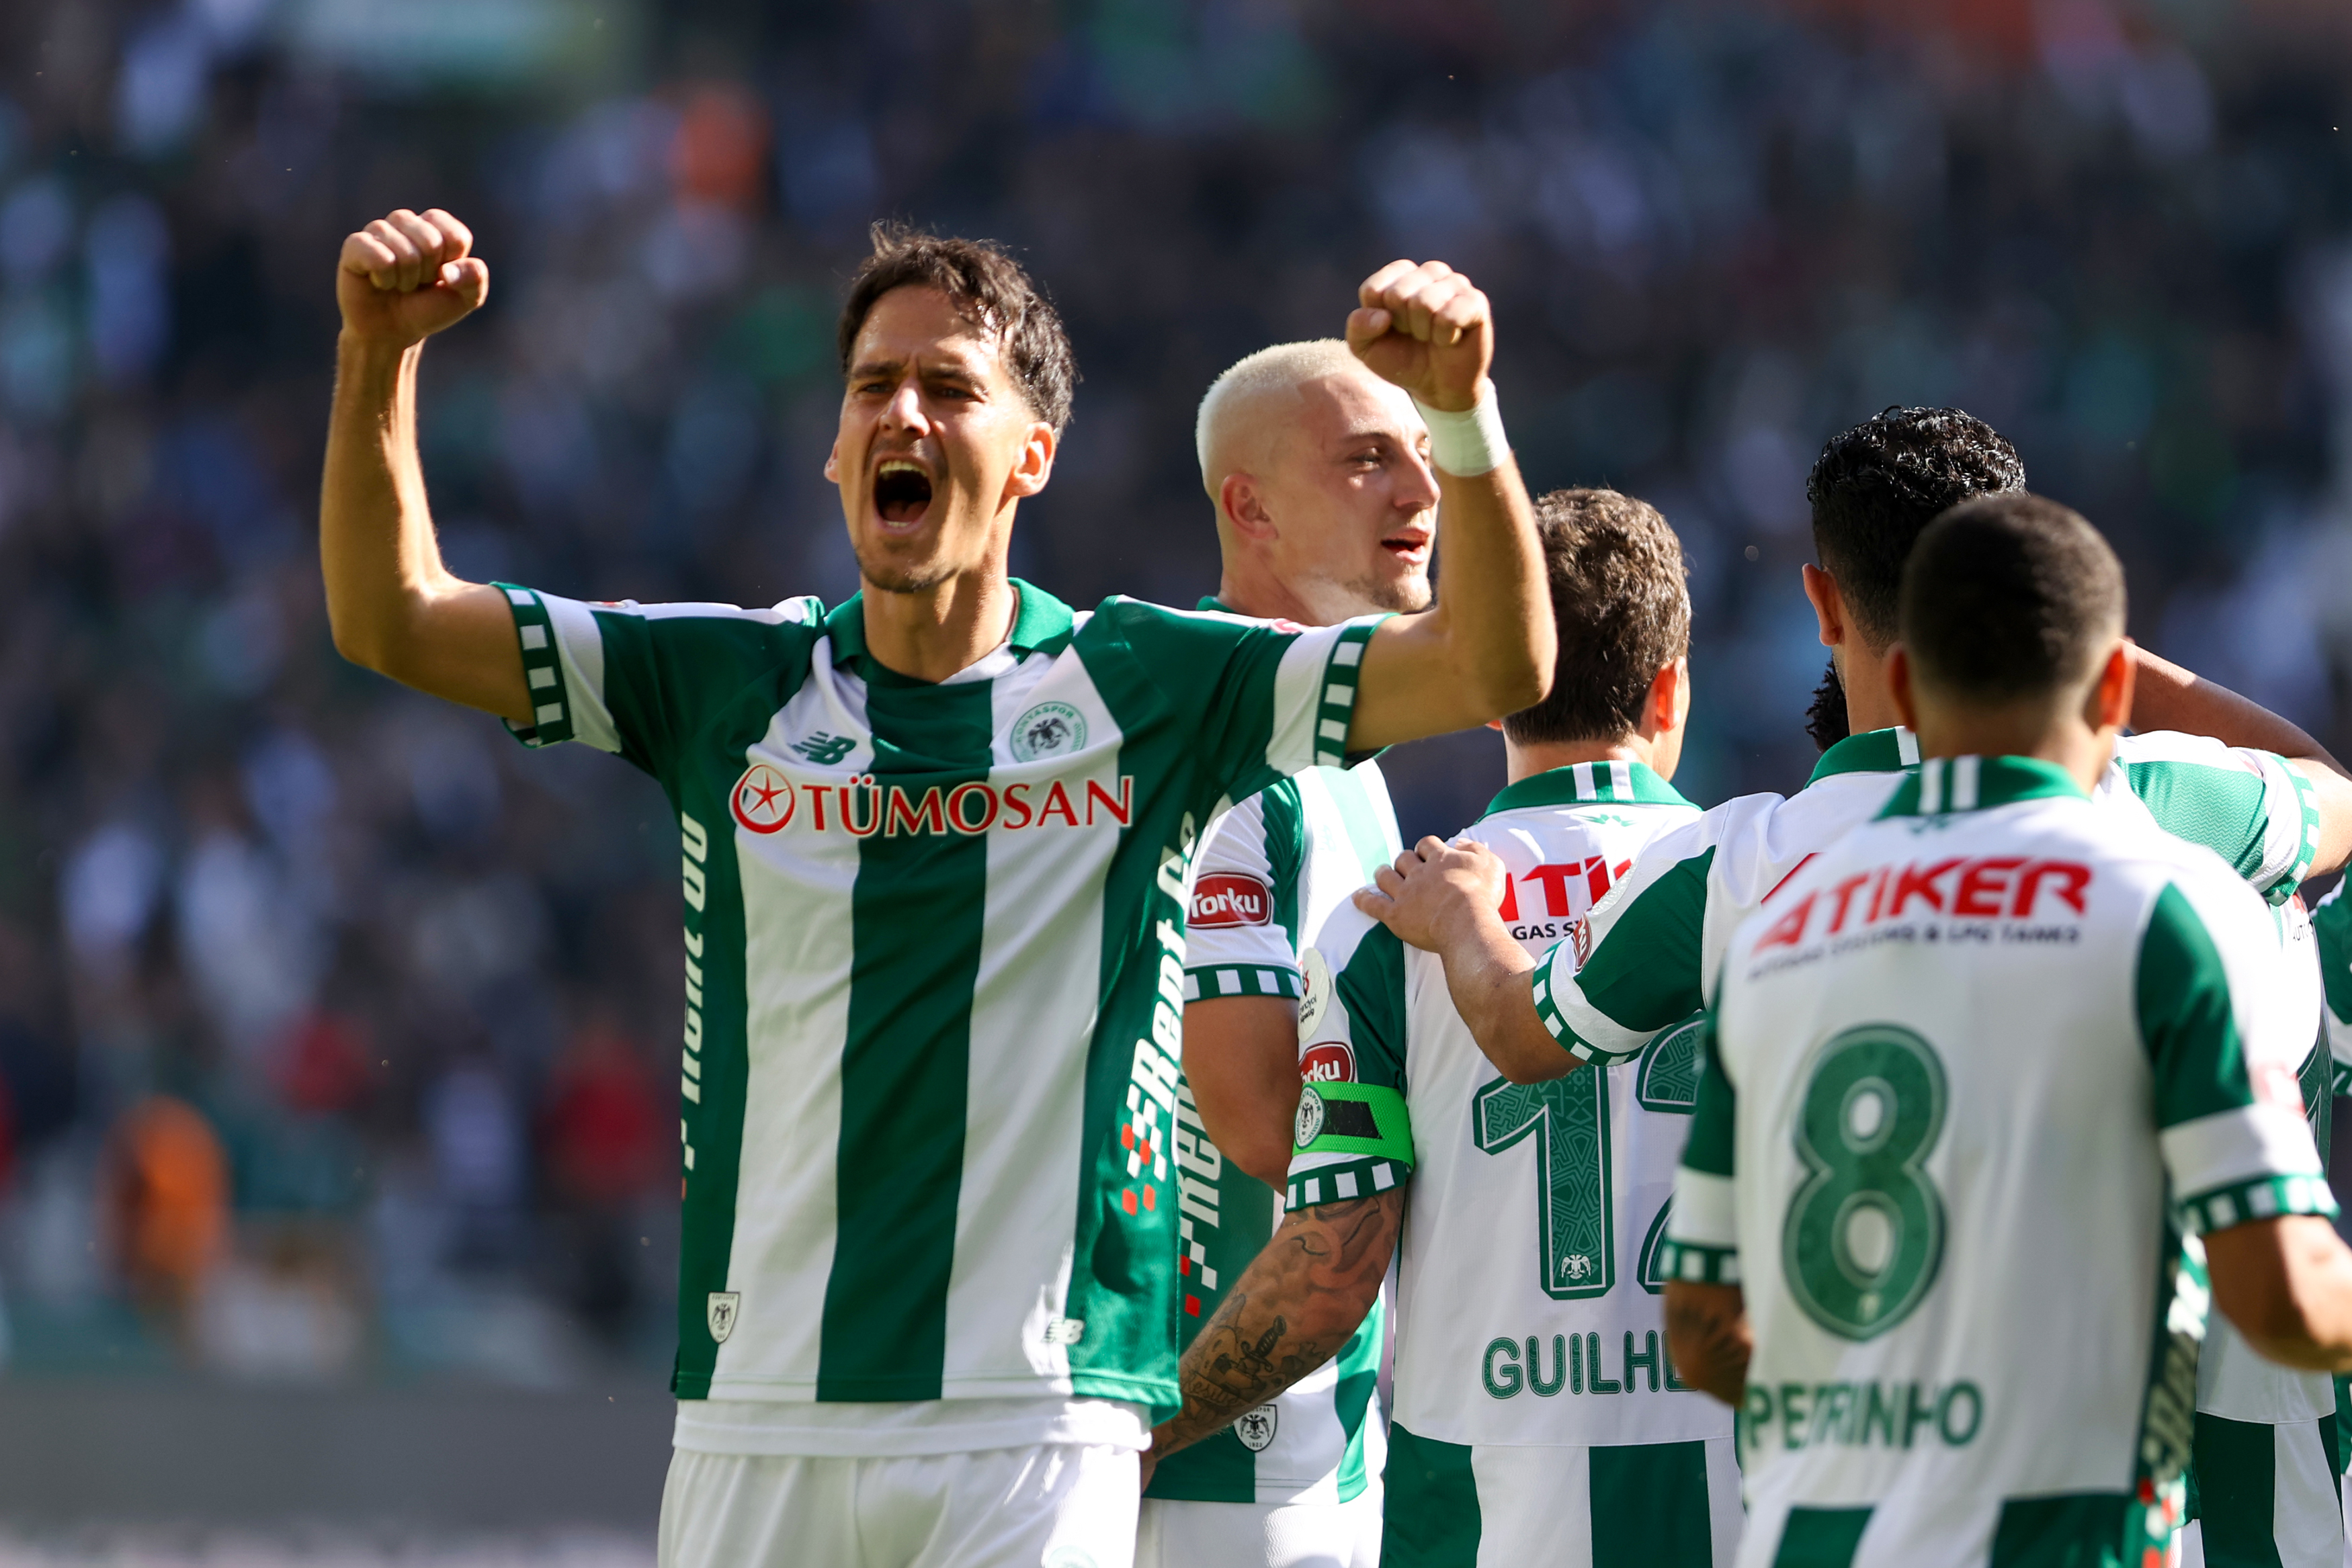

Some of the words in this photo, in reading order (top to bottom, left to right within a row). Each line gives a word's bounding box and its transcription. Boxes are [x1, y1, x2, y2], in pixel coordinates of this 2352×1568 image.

[800, 774, 1135, 838] TÜMOSAN
[1189, 887, 1261, 919] Torku
[1510, 922, 1557, 941] GAS
[1562, 920, 1580, 937] S
[1749, 855, 2092, 957] ATIKER
[1130, 917, 1186, 1115] Rent
[1300, 1059, 1341, 1083] rku
[1781, 1021, 1951, 1343] 8
